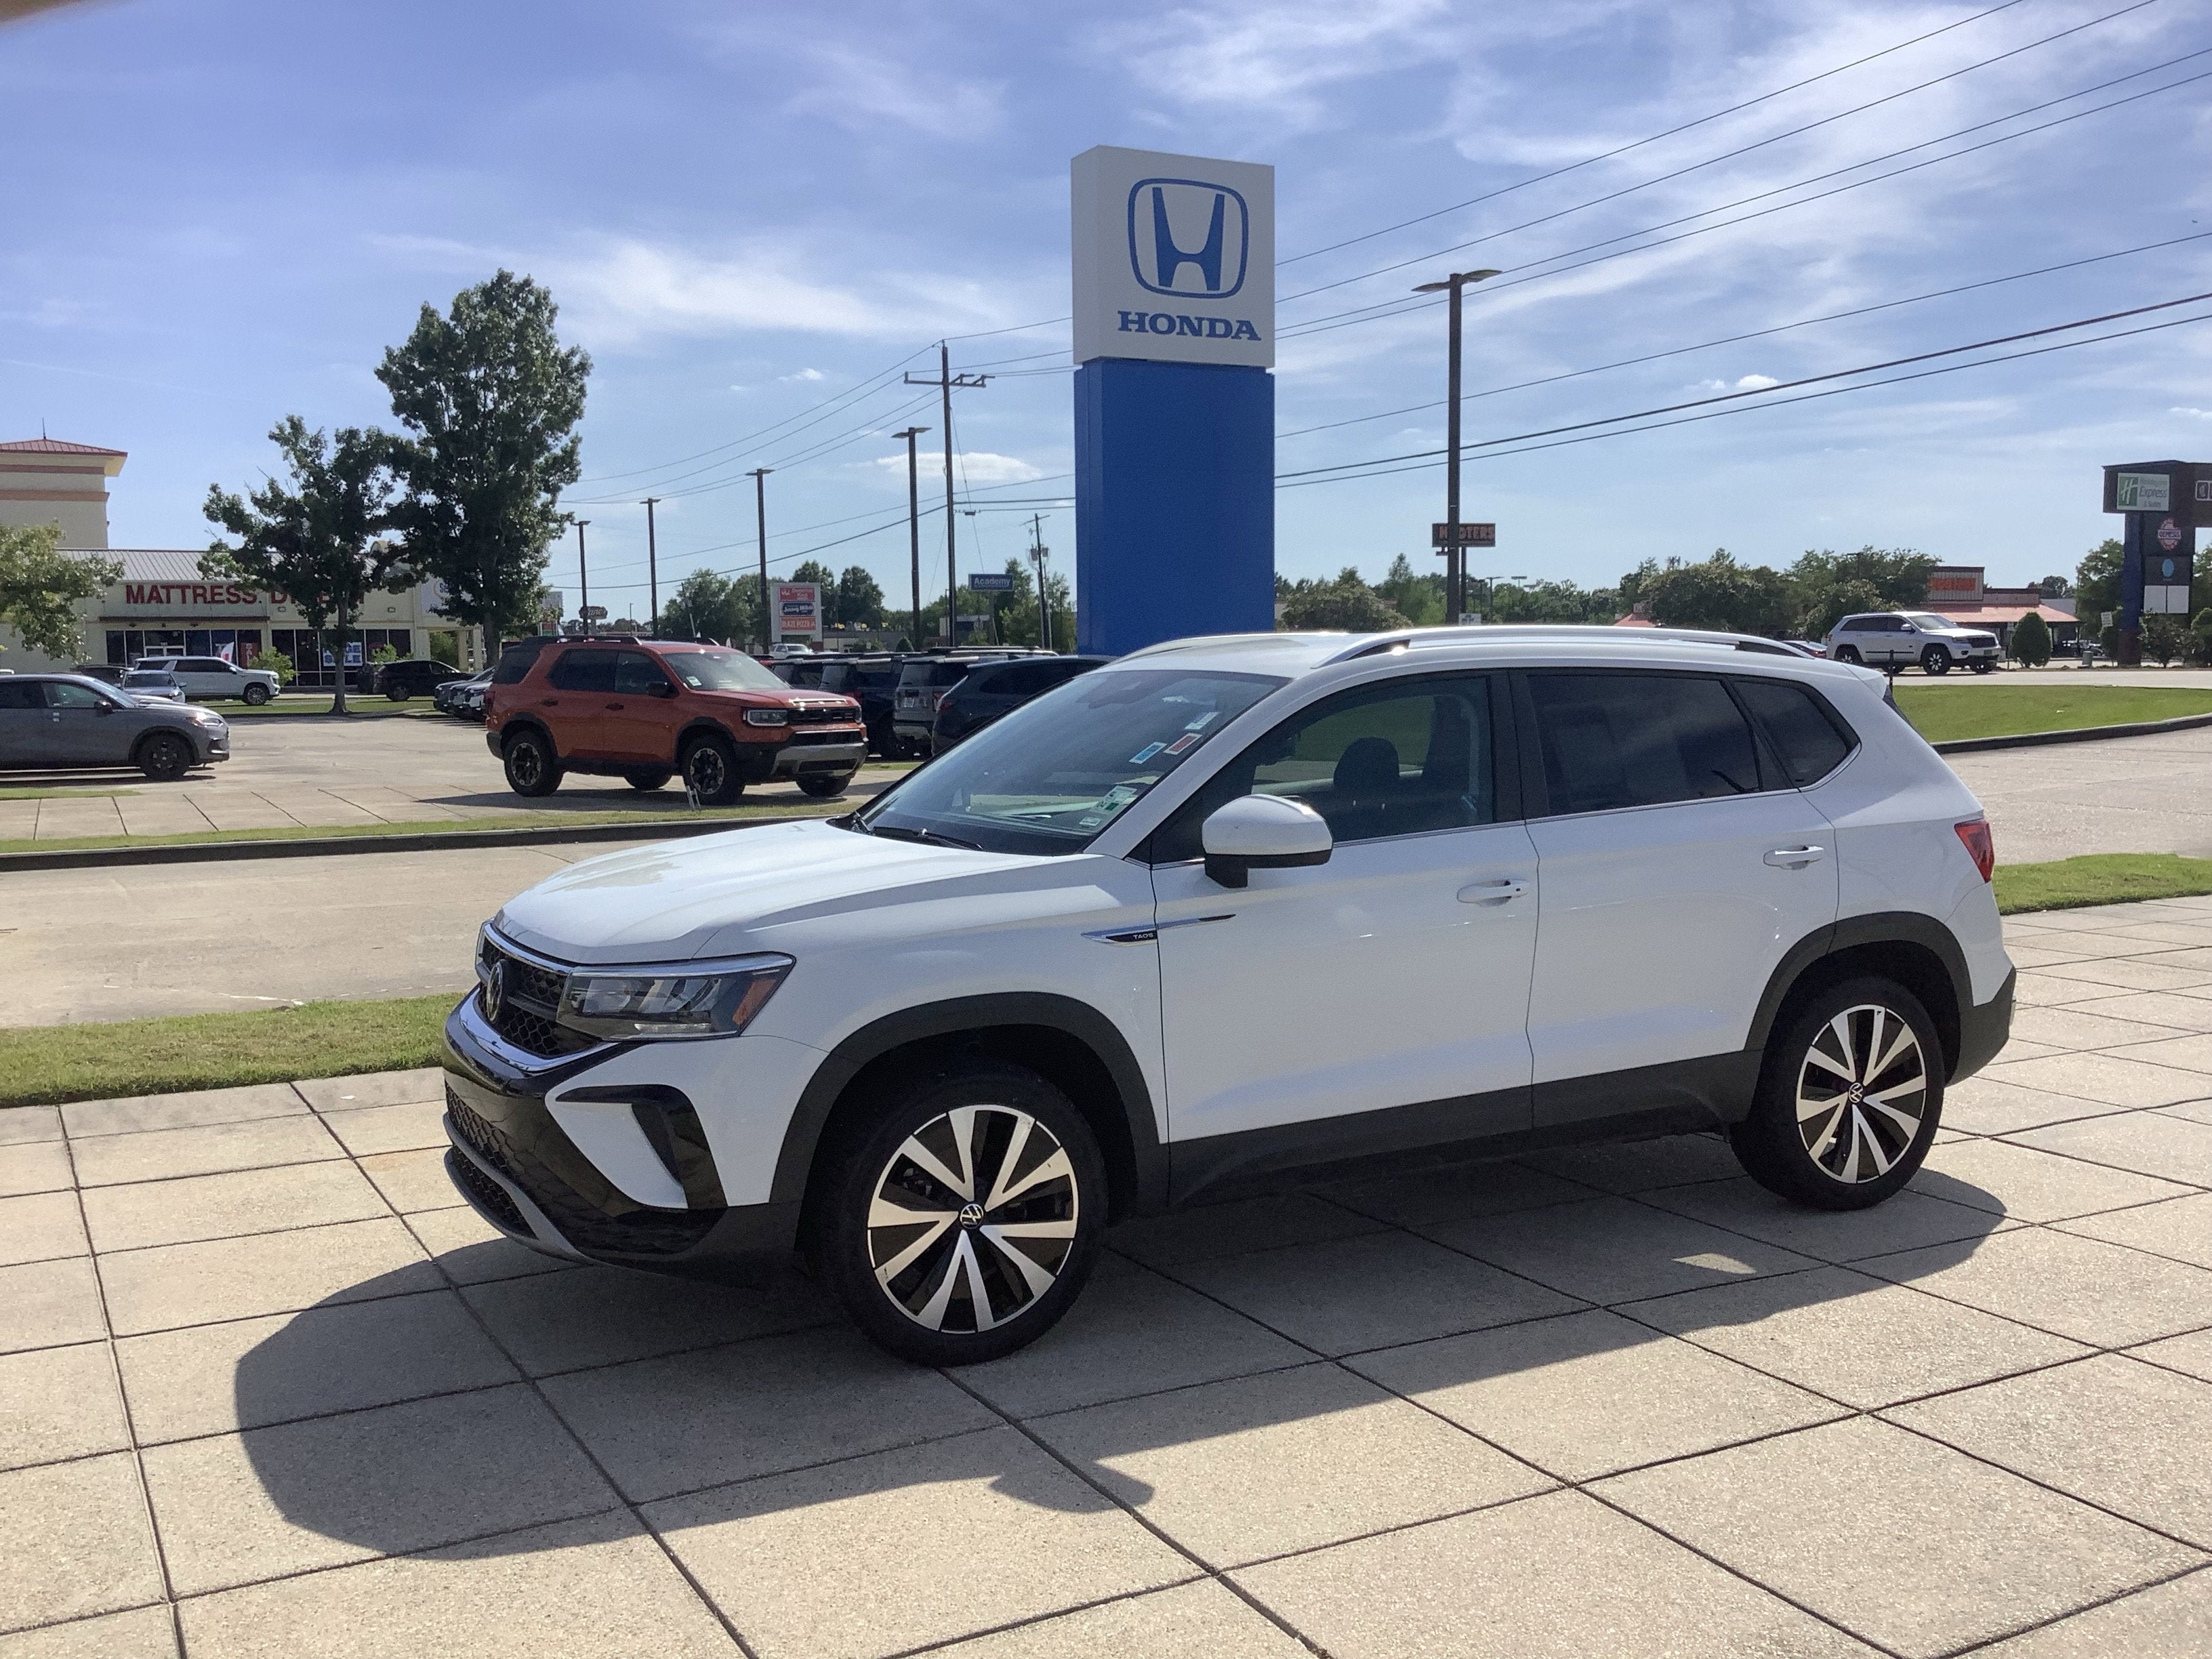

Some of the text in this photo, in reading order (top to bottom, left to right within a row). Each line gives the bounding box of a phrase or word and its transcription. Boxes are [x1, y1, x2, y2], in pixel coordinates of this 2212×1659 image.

[1118, 310, 1262, 342] HONDA
[2139, 486, 2167, 499] Express
[1439, 526, 1494, 540] HOTERS
[974, 577, 1010, 588] Academy
[125, 584, 258, 605] MATTRESS
